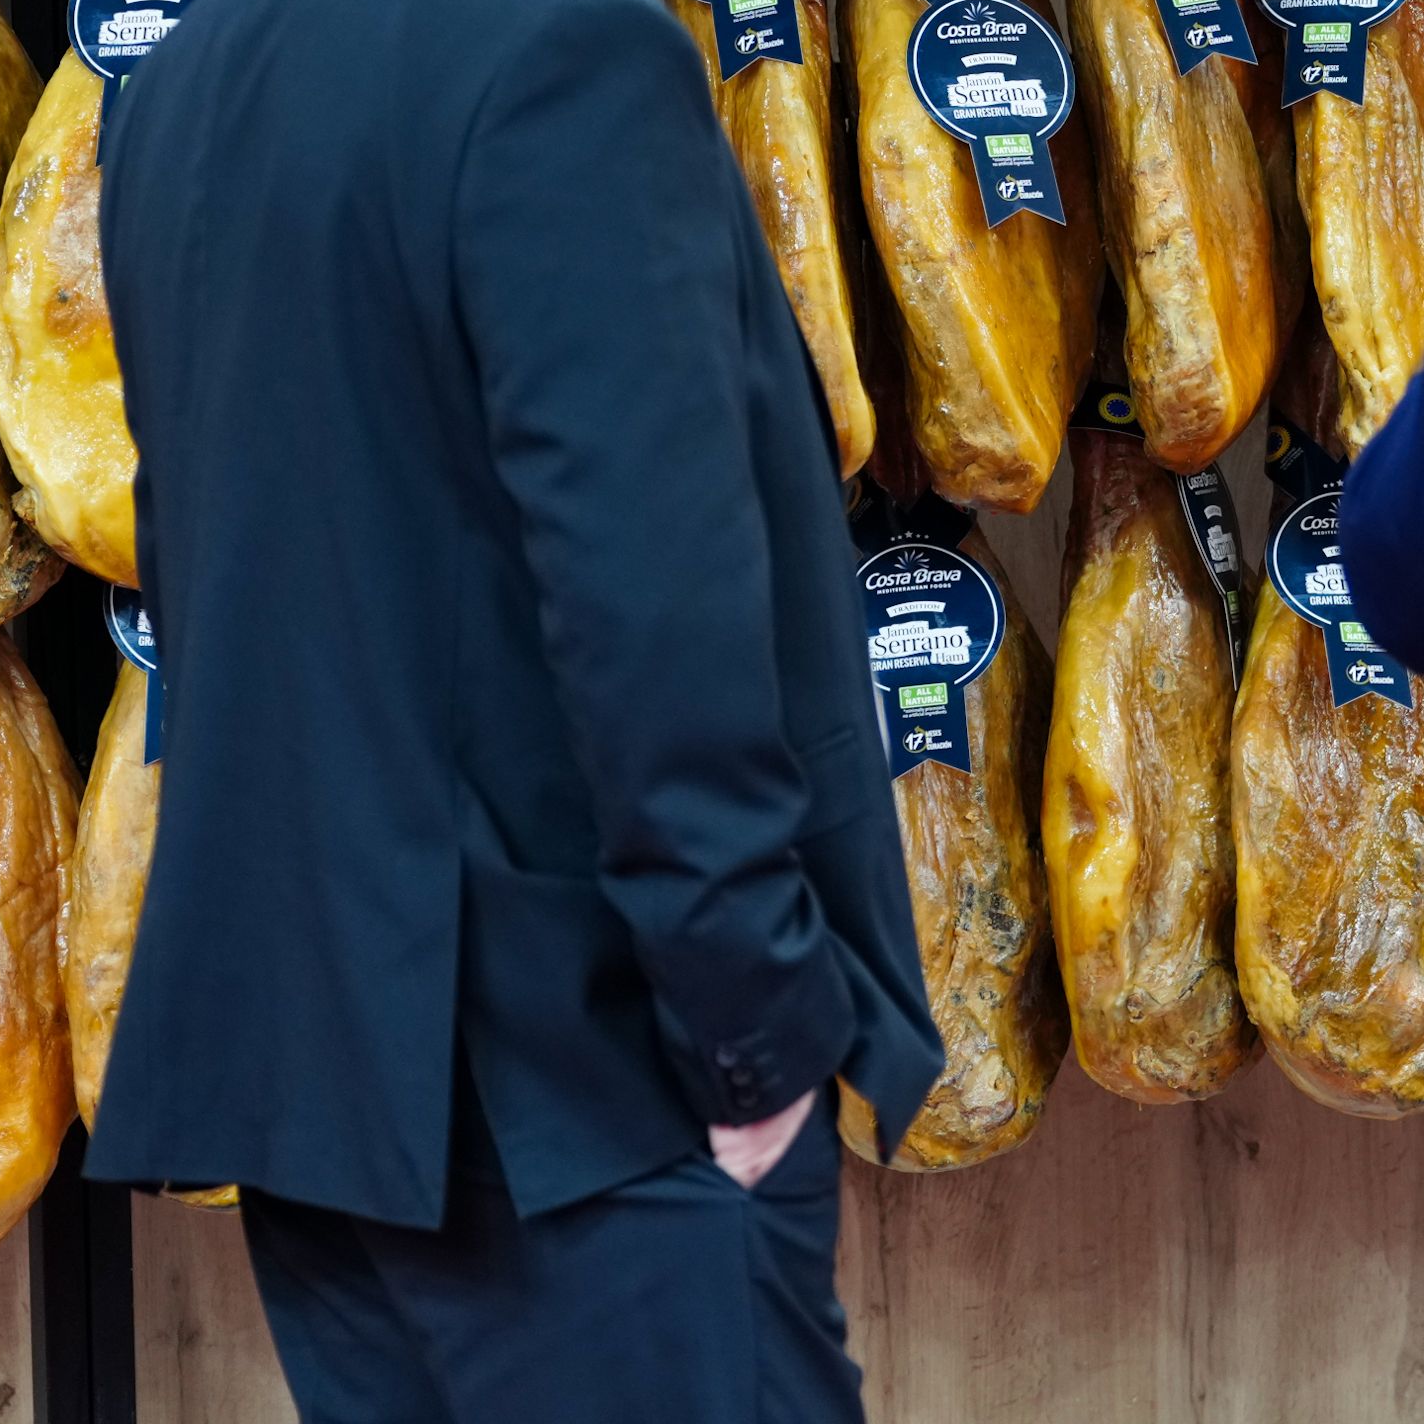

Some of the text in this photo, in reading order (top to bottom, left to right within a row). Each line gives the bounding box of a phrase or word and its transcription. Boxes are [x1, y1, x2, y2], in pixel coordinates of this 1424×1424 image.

[937, 20, 1029, 40] Costa Brava
[1320, 25, 1336, 33] ALL
[1302, 66, 1322, 82] 17
[1323, 64, 1340, 72] MESES
[1322, 75, 1348, 84] CURACIÓN
[953, 85, 1040, 106] Serrano
[866, 568, 962, 591] Costa Brava
[873, 632, 964, 657] Serrano
